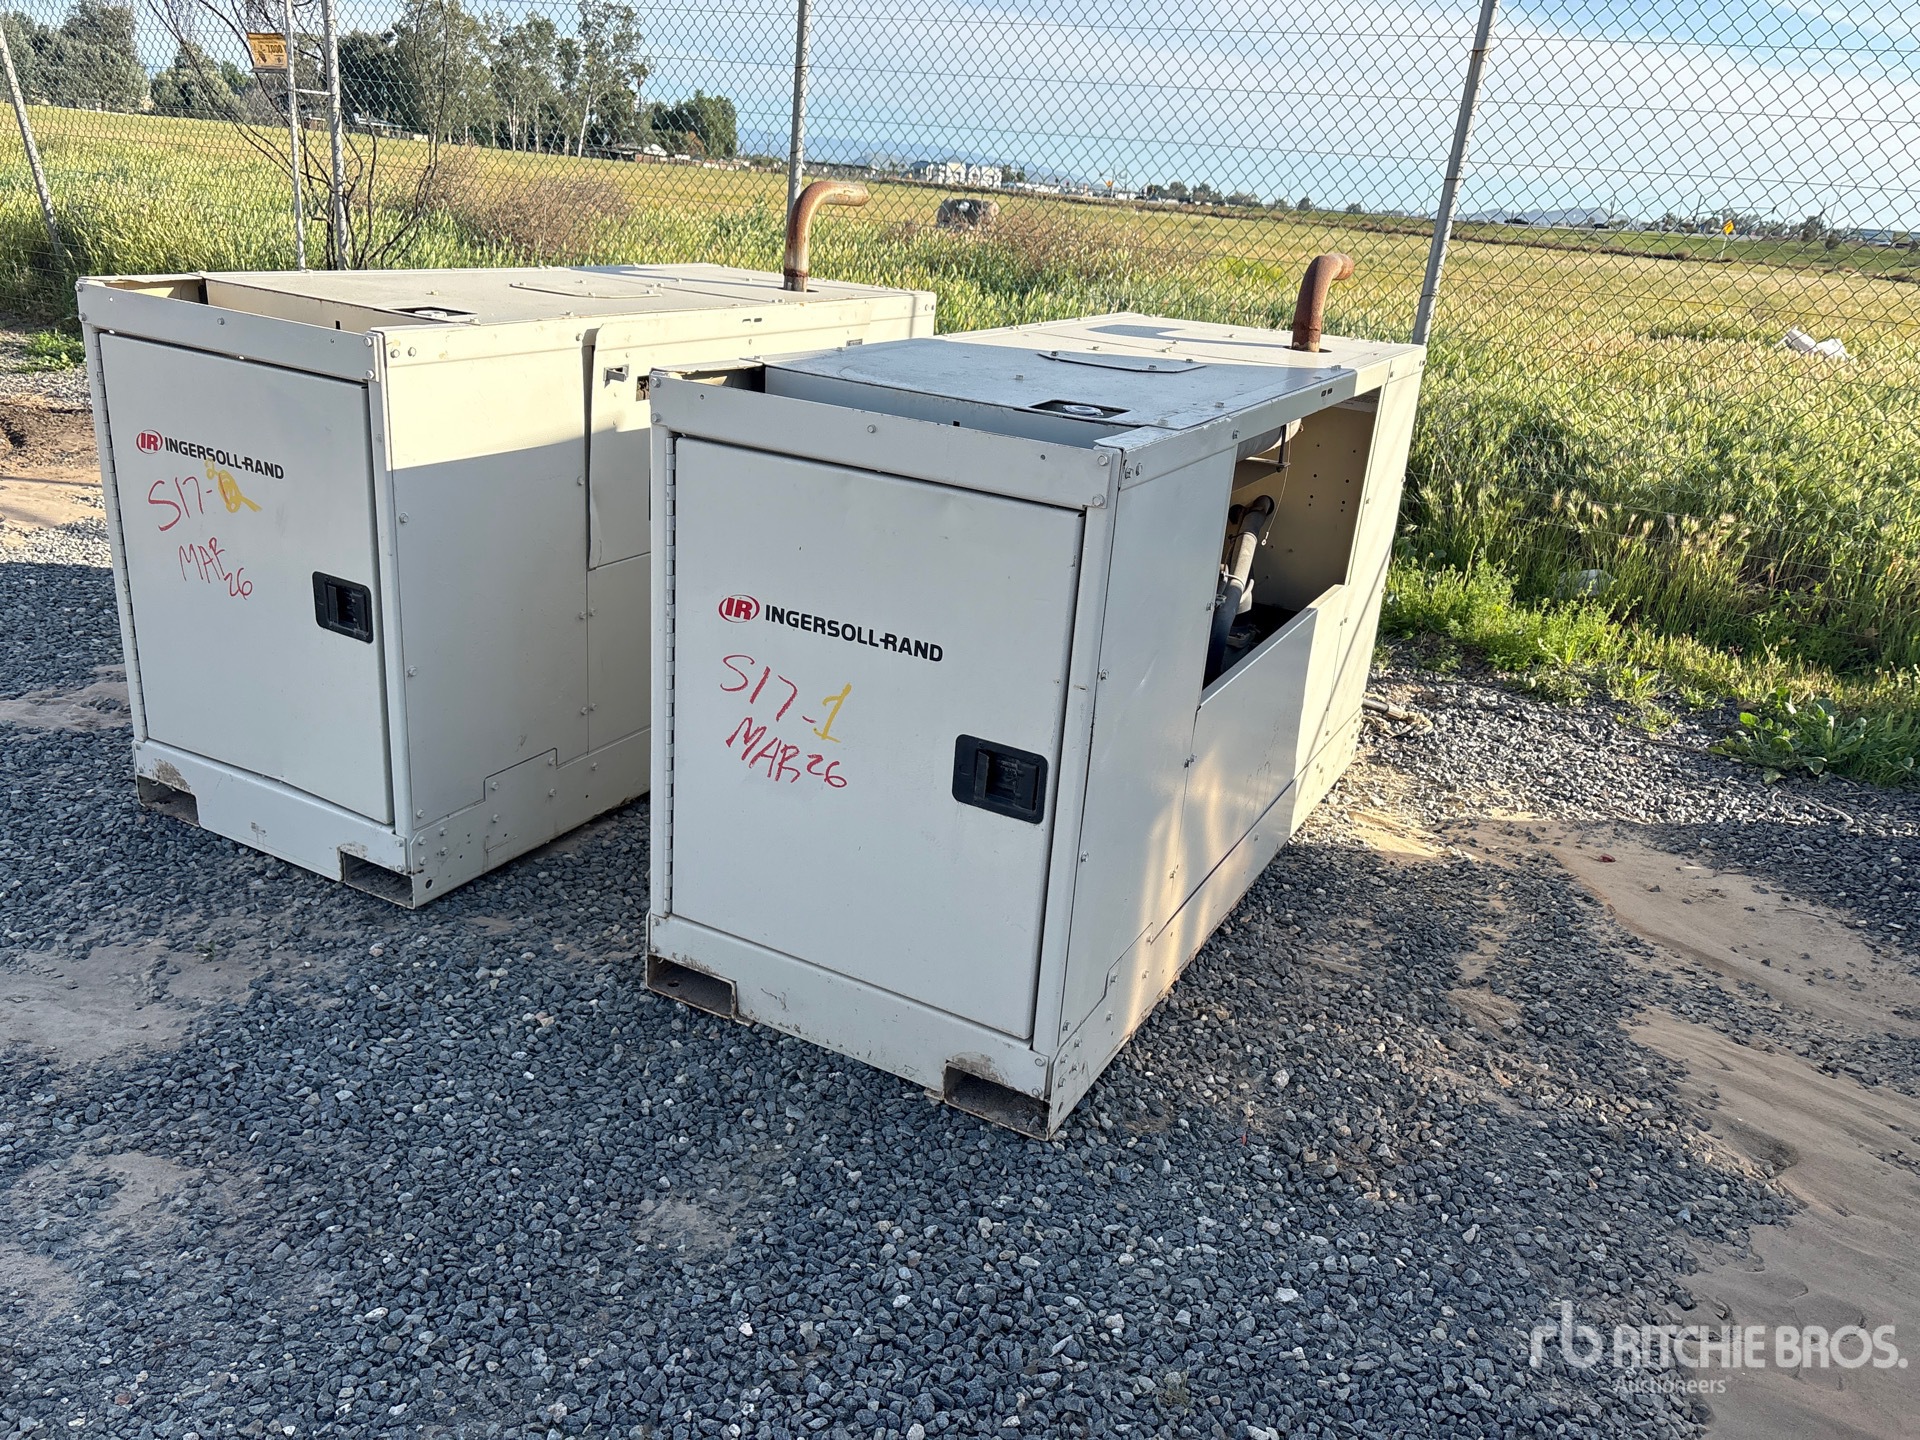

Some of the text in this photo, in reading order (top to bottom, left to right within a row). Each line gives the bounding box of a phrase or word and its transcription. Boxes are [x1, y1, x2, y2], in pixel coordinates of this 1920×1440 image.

[138, 430, 284, 479] IR INGERSOLL-RAND
[722, 595, 943, 662] IR INGERSOLL-RAND
